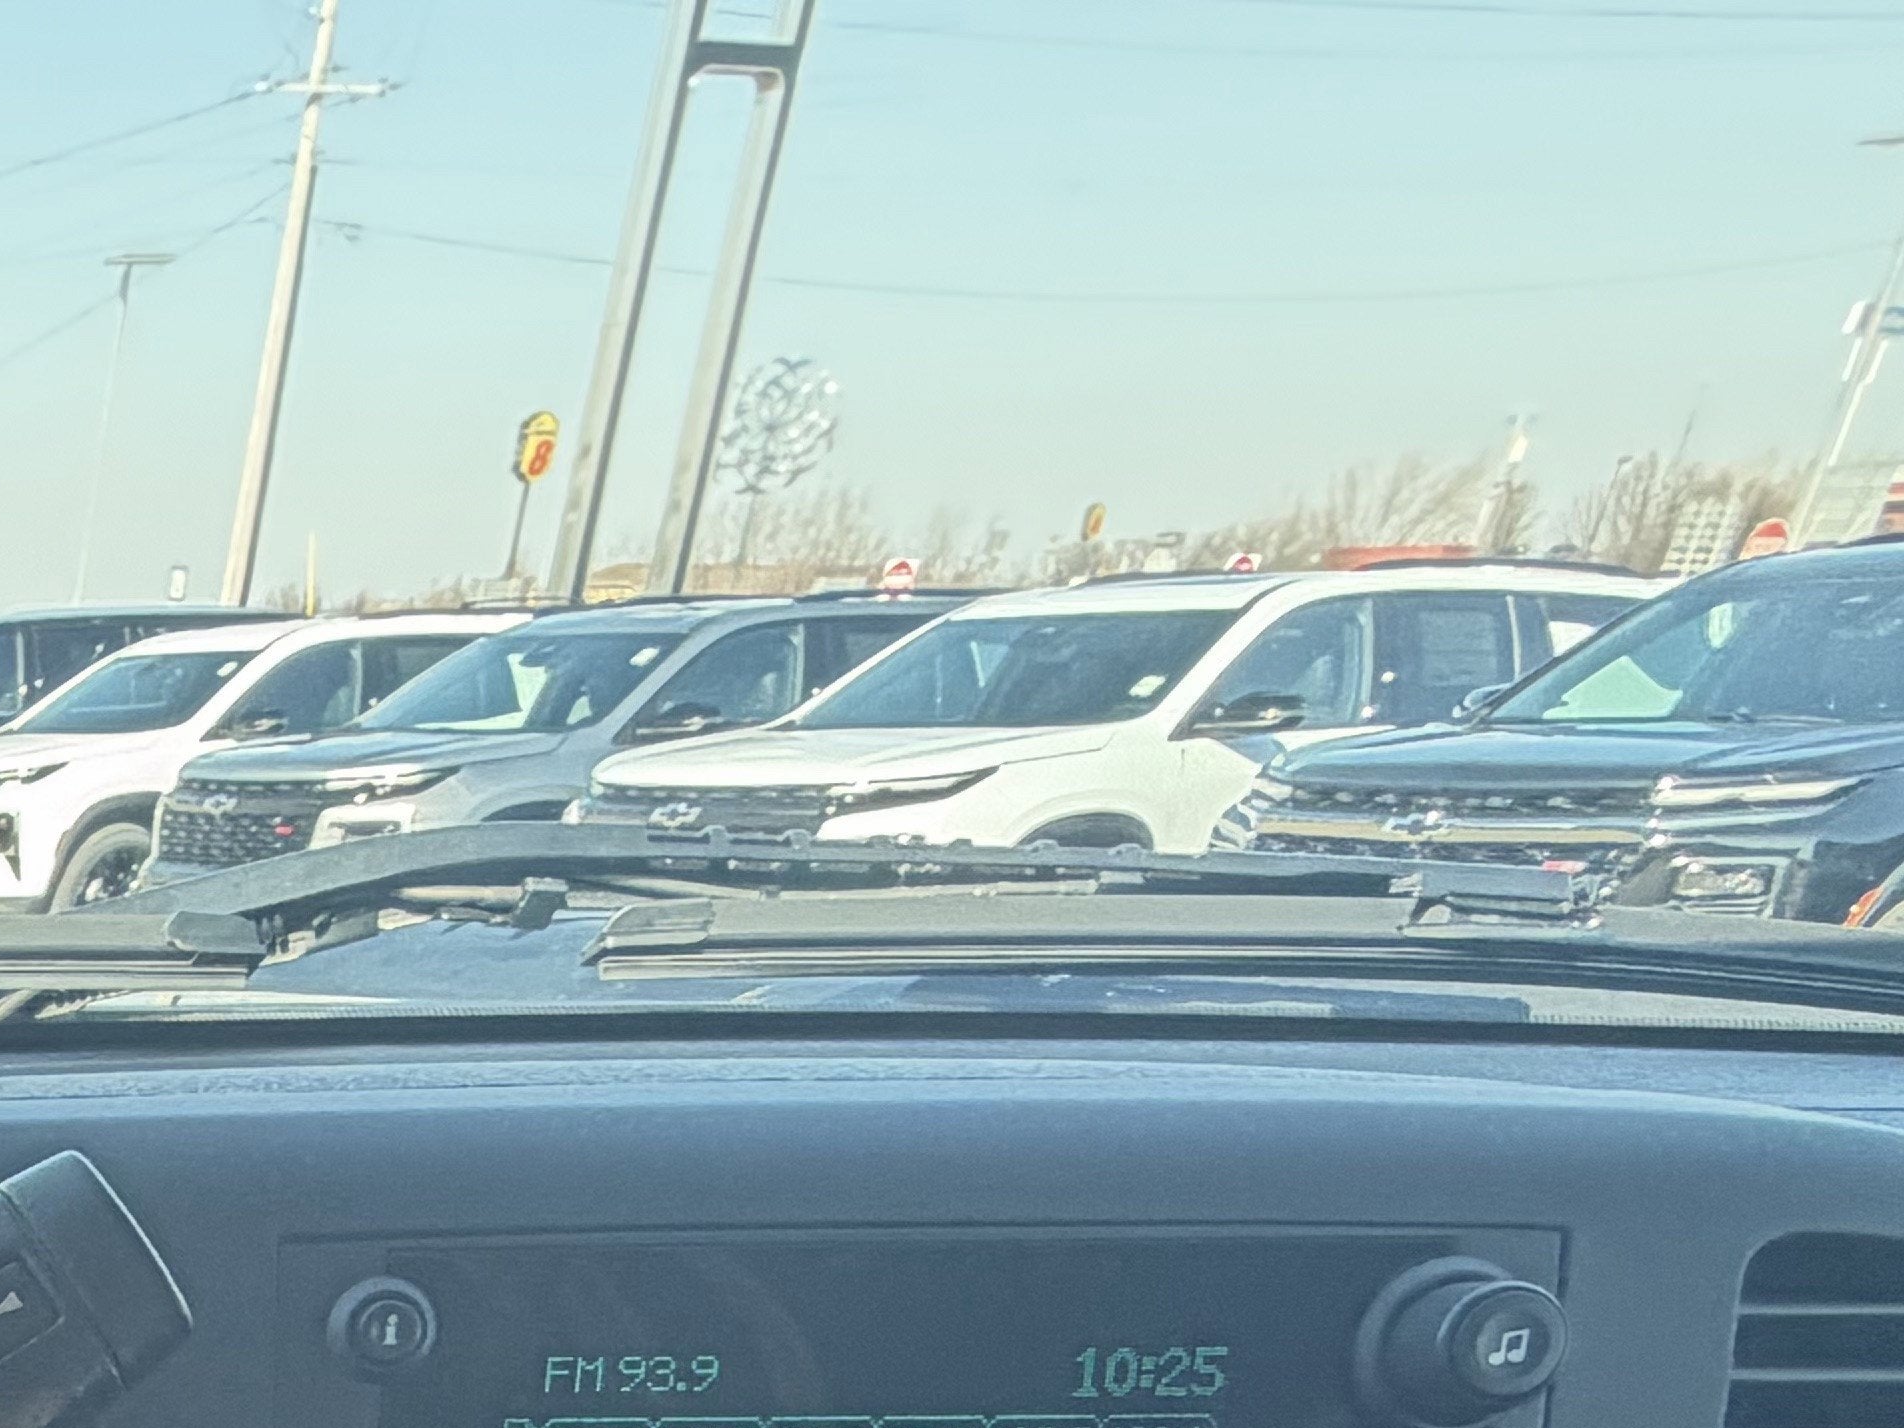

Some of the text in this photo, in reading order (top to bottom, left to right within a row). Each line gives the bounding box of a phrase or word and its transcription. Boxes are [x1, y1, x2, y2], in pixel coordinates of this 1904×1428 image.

[544, 1355, 720, 1394] FM 93.9
[1073, 1346, 1229, 1397] 10:25
